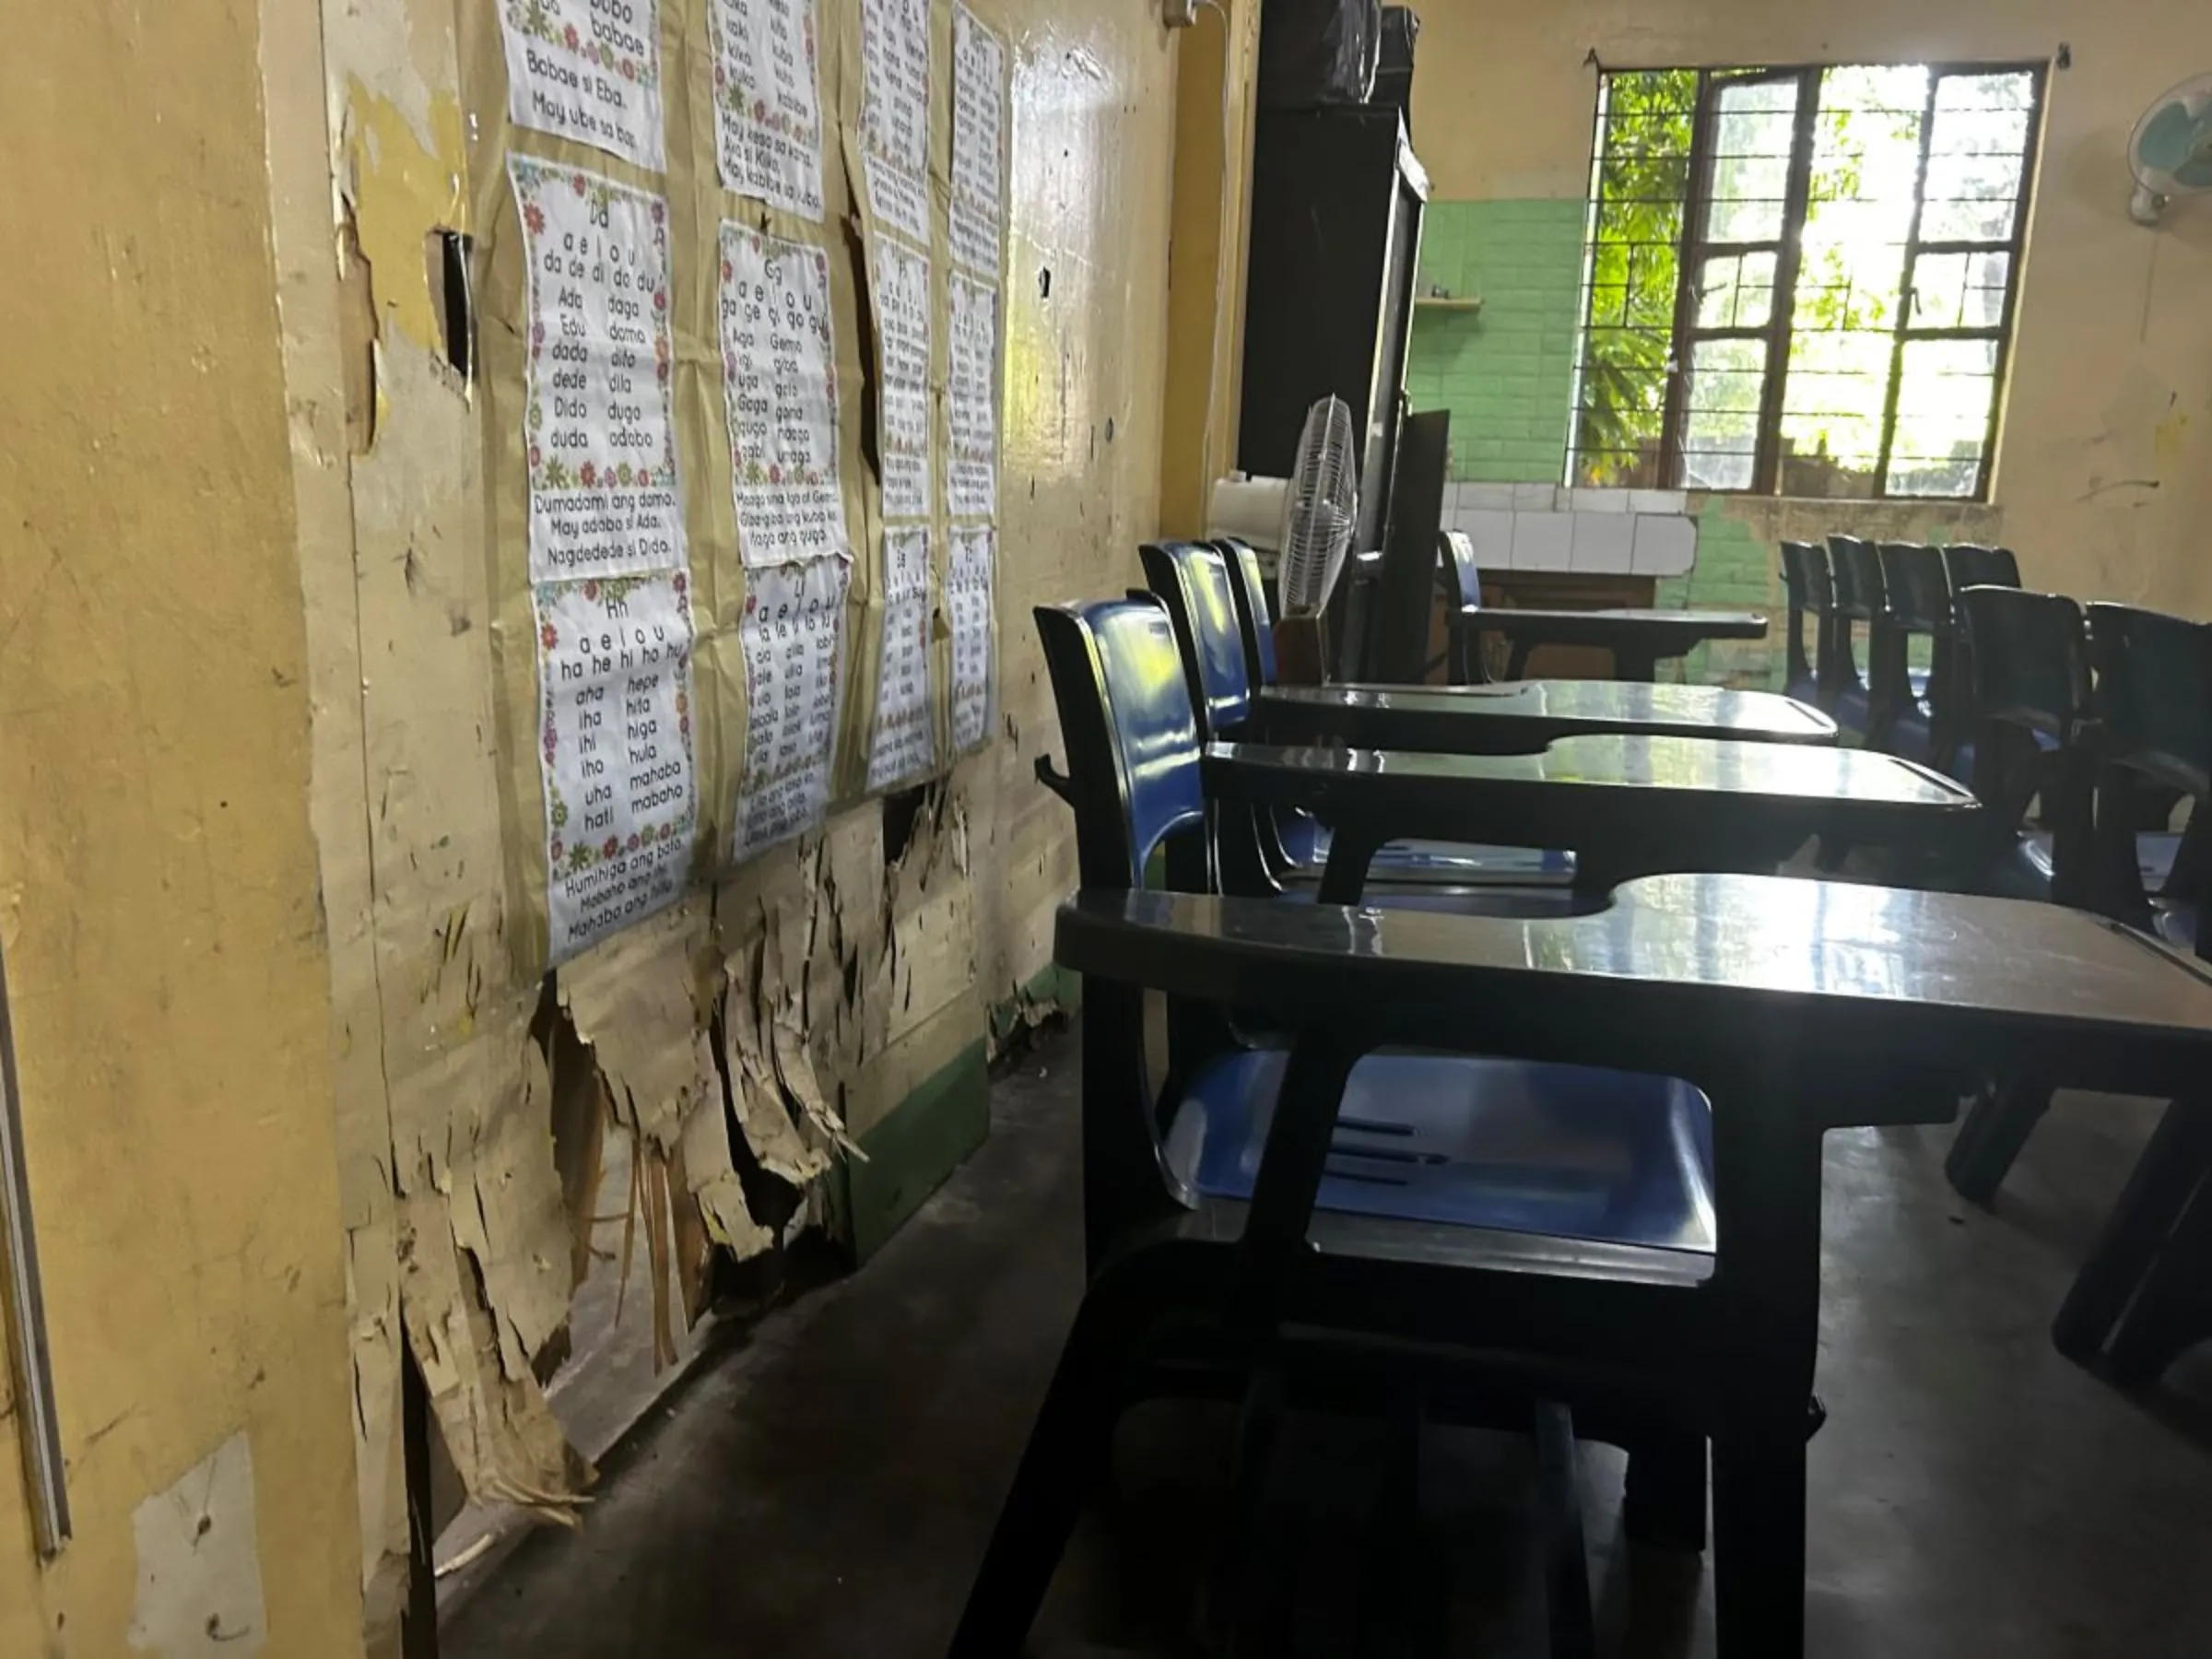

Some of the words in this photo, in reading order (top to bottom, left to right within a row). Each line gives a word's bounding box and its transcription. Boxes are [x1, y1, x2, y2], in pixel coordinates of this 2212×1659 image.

[591, 11, 644, 56] babae
[526, 48, 578, 88] Babae
[582, 76, 593, 95] si
[533, 89, 566, 124] May
[563, 232, 574, 252] a
[580, 236, 589, 256] e
[609, 244, 620, 263] o
[628, 249, 636, 267] u
[544, 250, 562, 275] da
[569, 255, 585, 279] de
[637, 273, 655, 294] du
[559, 285, 583, 310] Ada
[608, 294, 640, 321] daga
[738, 280, 747, 300] a
[755, 285, 764, 302] e
[785, 290, 795, 309] o
[803, 291, 812, 312] u
[552, 338, 588, 363] dada
[552, 368, 587, 391] dede
[609, 373, 631, 394] dila
[555, 396, 587, 418] Dido
[551, 428, 589, 448] duda
[534, 492, 609, 514] Dumadami
[611, 495, 635, 513] ang
[551, 518, 579, 539] May
[582, 516, 624, 535] adobo
[626, 514, 633, 530] si
[637, 512, 662, 529] Ada.
[547, 541, 624, 568] Nagdedede
[759, 606, 770, 623] a
[777, 602, 788, 619] e
[808, 597, 819, 615] o
[580, 636, 591, 654] a
[601, 633, 611, 651] e
[618, 625, 626, 647] i
[635, 628, 646, 644] o
[653, 625, 665, 641] u
[560, 659, 583, 681] ha
[592, 655, 611, 675] he
[620, 649, 633, 669] hi
[575, 685, 605, 706] aha
[627, 674, 659, 693] hepe
[626, 697, 651, 717] hita
[579, 711, 602, 731] iha
[628, 719, 657, 740] higa
[579, 734, 597, 755] ihi
[628, 745, 657, 766] hula
[581, 759, 604, 779] iho
[629, 760, 682, 791] mahaba
[584, 784, 612, 806] uha
[630, 783, 683, 815] mabaho
[584, 806, 615, 832] hati
[565, 861, 627, 899] Humihiga
[629, 850, 653, 870] ang
[567, 904, 622, 943] Mahaba
